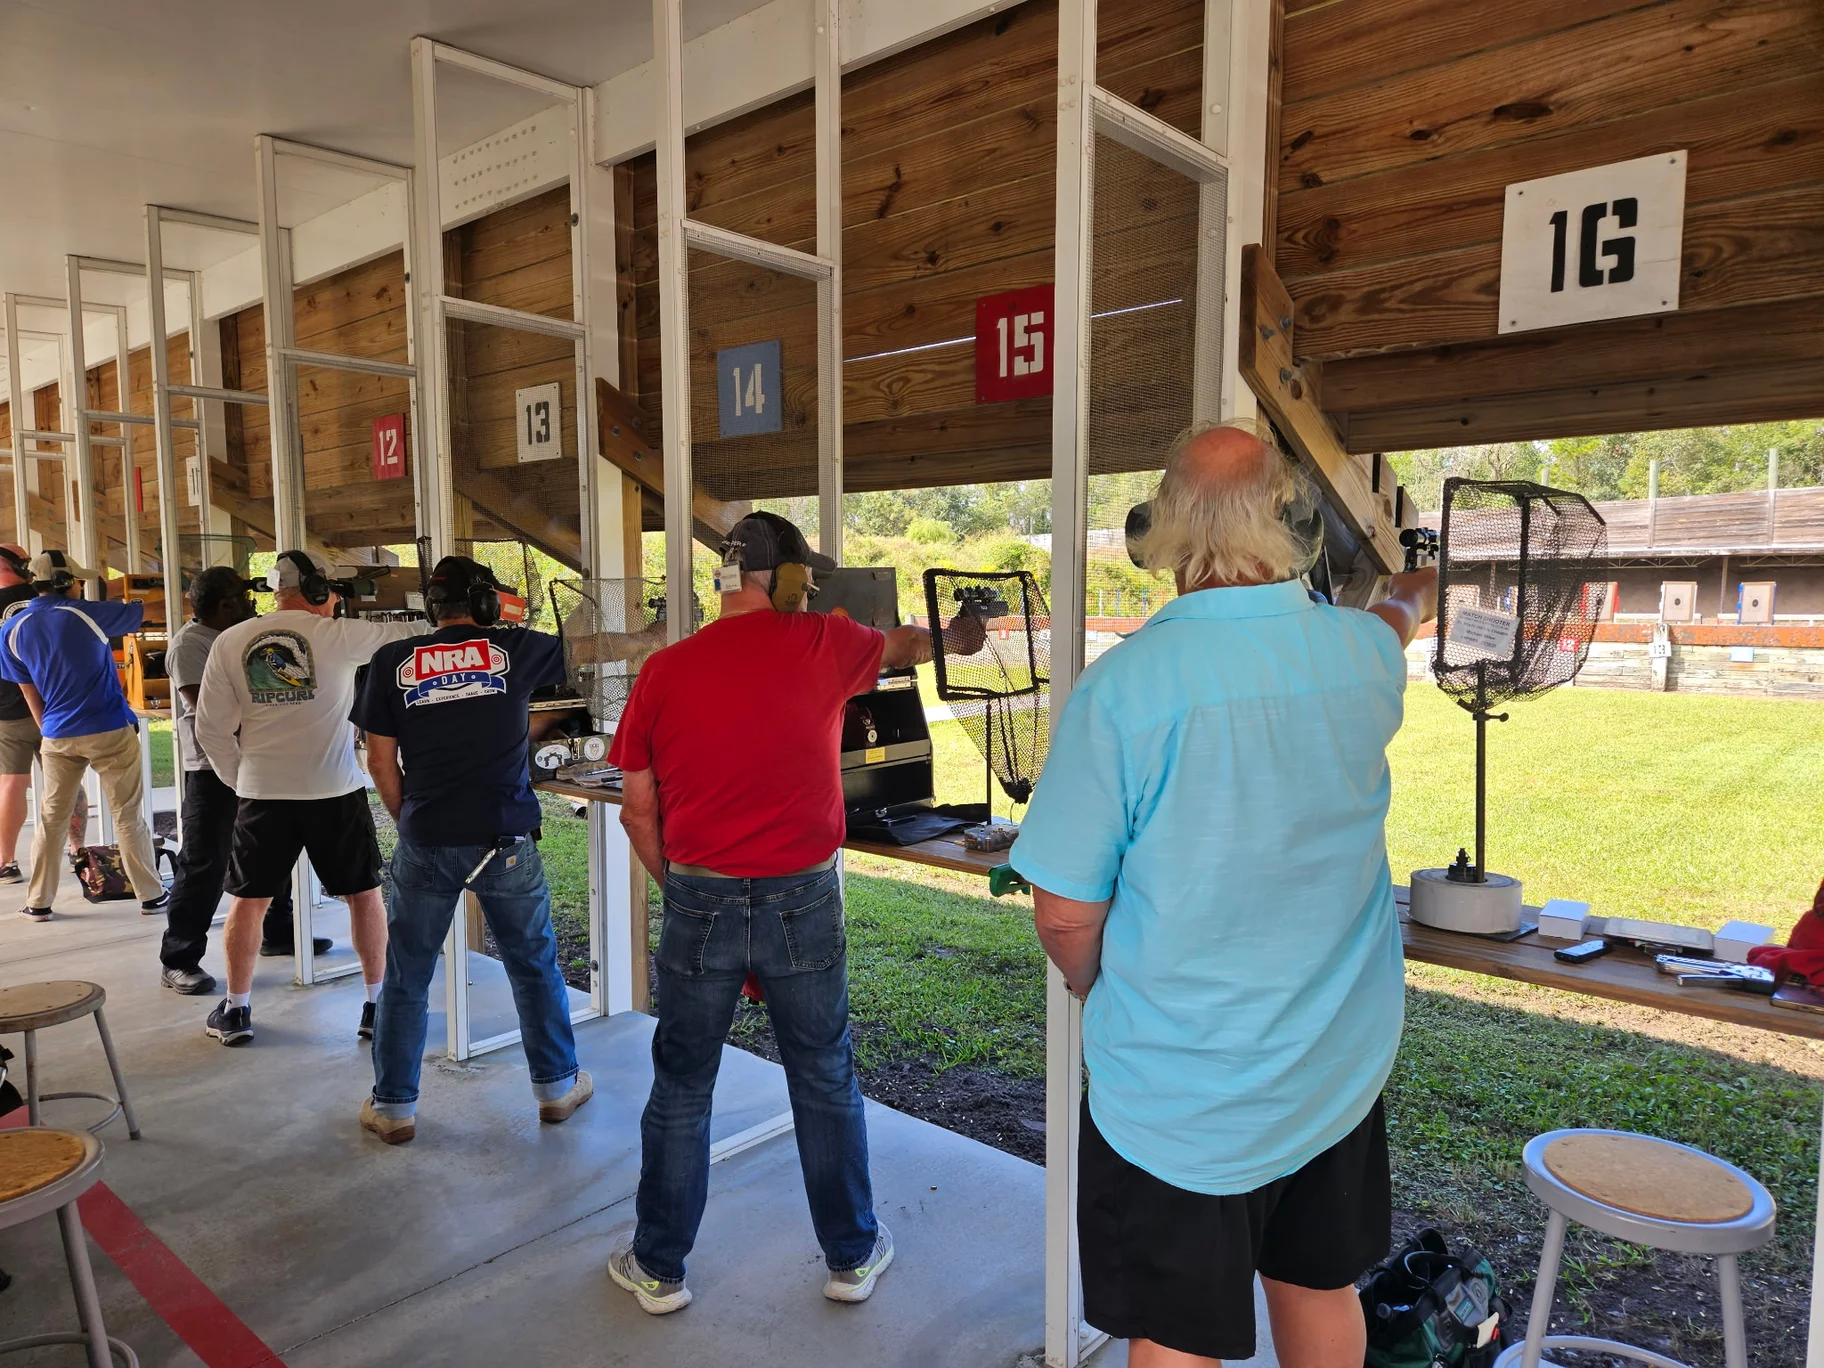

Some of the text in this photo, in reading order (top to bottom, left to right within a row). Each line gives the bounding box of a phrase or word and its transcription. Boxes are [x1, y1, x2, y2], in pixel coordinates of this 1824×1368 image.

[1548, 197, 1638, 293] 16
[996, 311, 1045, 378] 15
[733, 363, 765, 416] 14
[525, 401, 550, 445] 13
[379, 428, 398, 466] 12
[1462, 610, 1483, 620] MATCH
[1483, 616, 1511, 627] SHOOTER
[1562, 638, 1575, 651] 12
[1654, 644, 1666, 655] 13
[421, 646, 485, 675] NRA
[441, 672, 466, 685] DAY
[252, 689, 315, 704] RIPCURL
